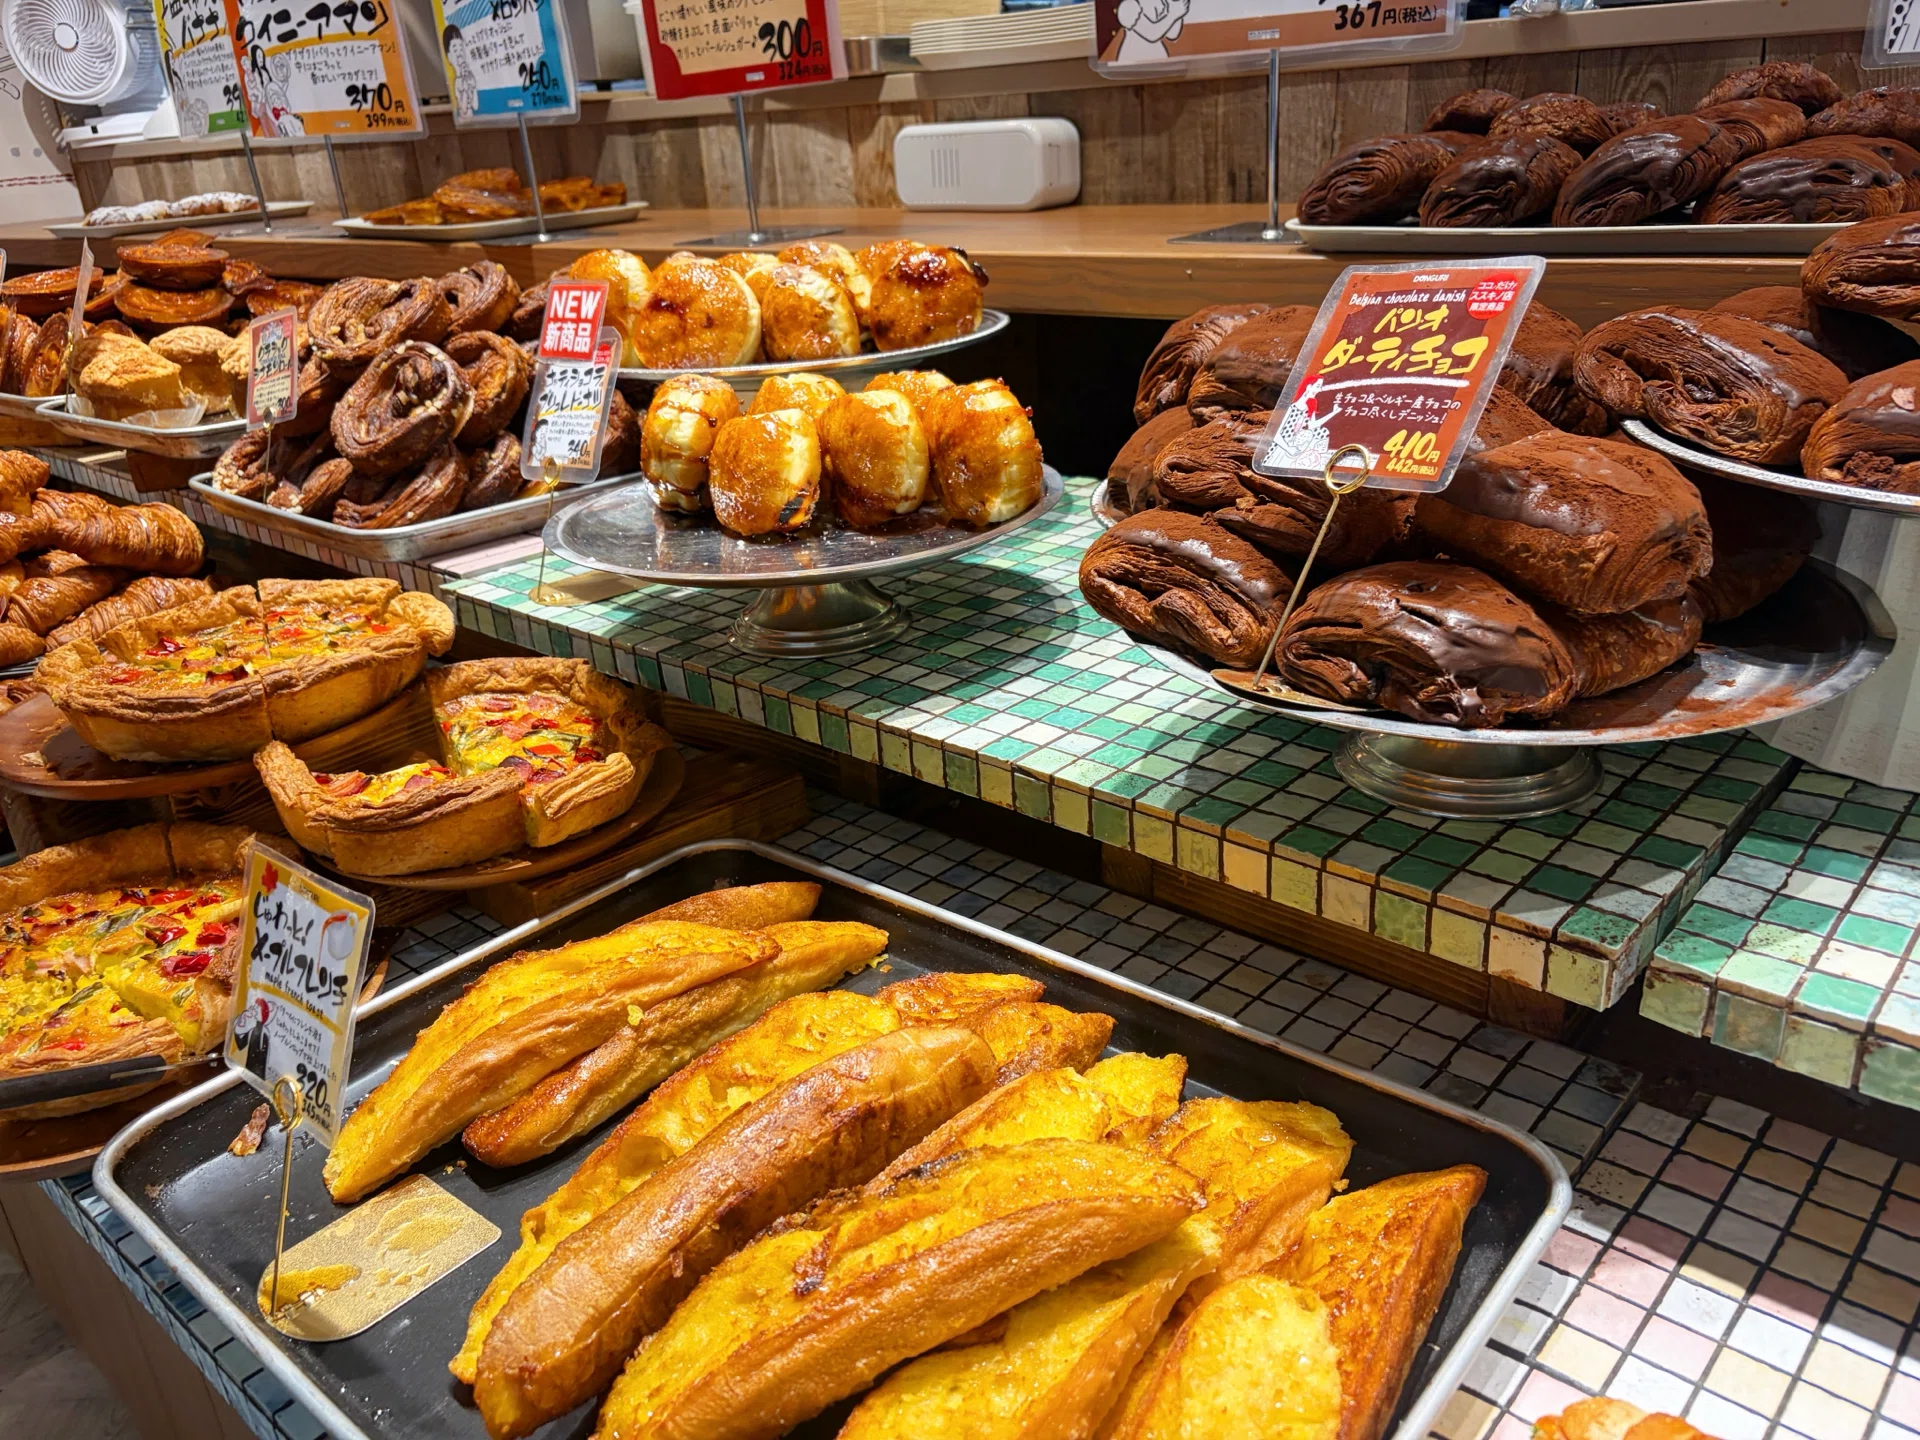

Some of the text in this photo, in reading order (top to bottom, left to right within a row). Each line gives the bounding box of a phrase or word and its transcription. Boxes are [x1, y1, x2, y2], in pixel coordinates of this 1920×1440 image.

[1334, 1, 1437, 30] 367円(税込)
[759, 17, 823, 63] 300円
[519, 60, 560, 92] 250円
[346, 83, 405, 113] 370円
[1413, 273, 1449, 283] DONGURI
[550, 290, 601, 319] NEW
[1349, 289, 1466, 308] Belgian chocolate danish
[1469, 291, 1514, 301] ススキノ店
[543, 321, 592, 353] 新商品
[1318, 334, 1489, 375] ダーティチョコ
[1383, 429, 1441, 462] 410円
[265, 971, 324, 1020] maple french toast
[296, 1063, 331, 1117] 320円
